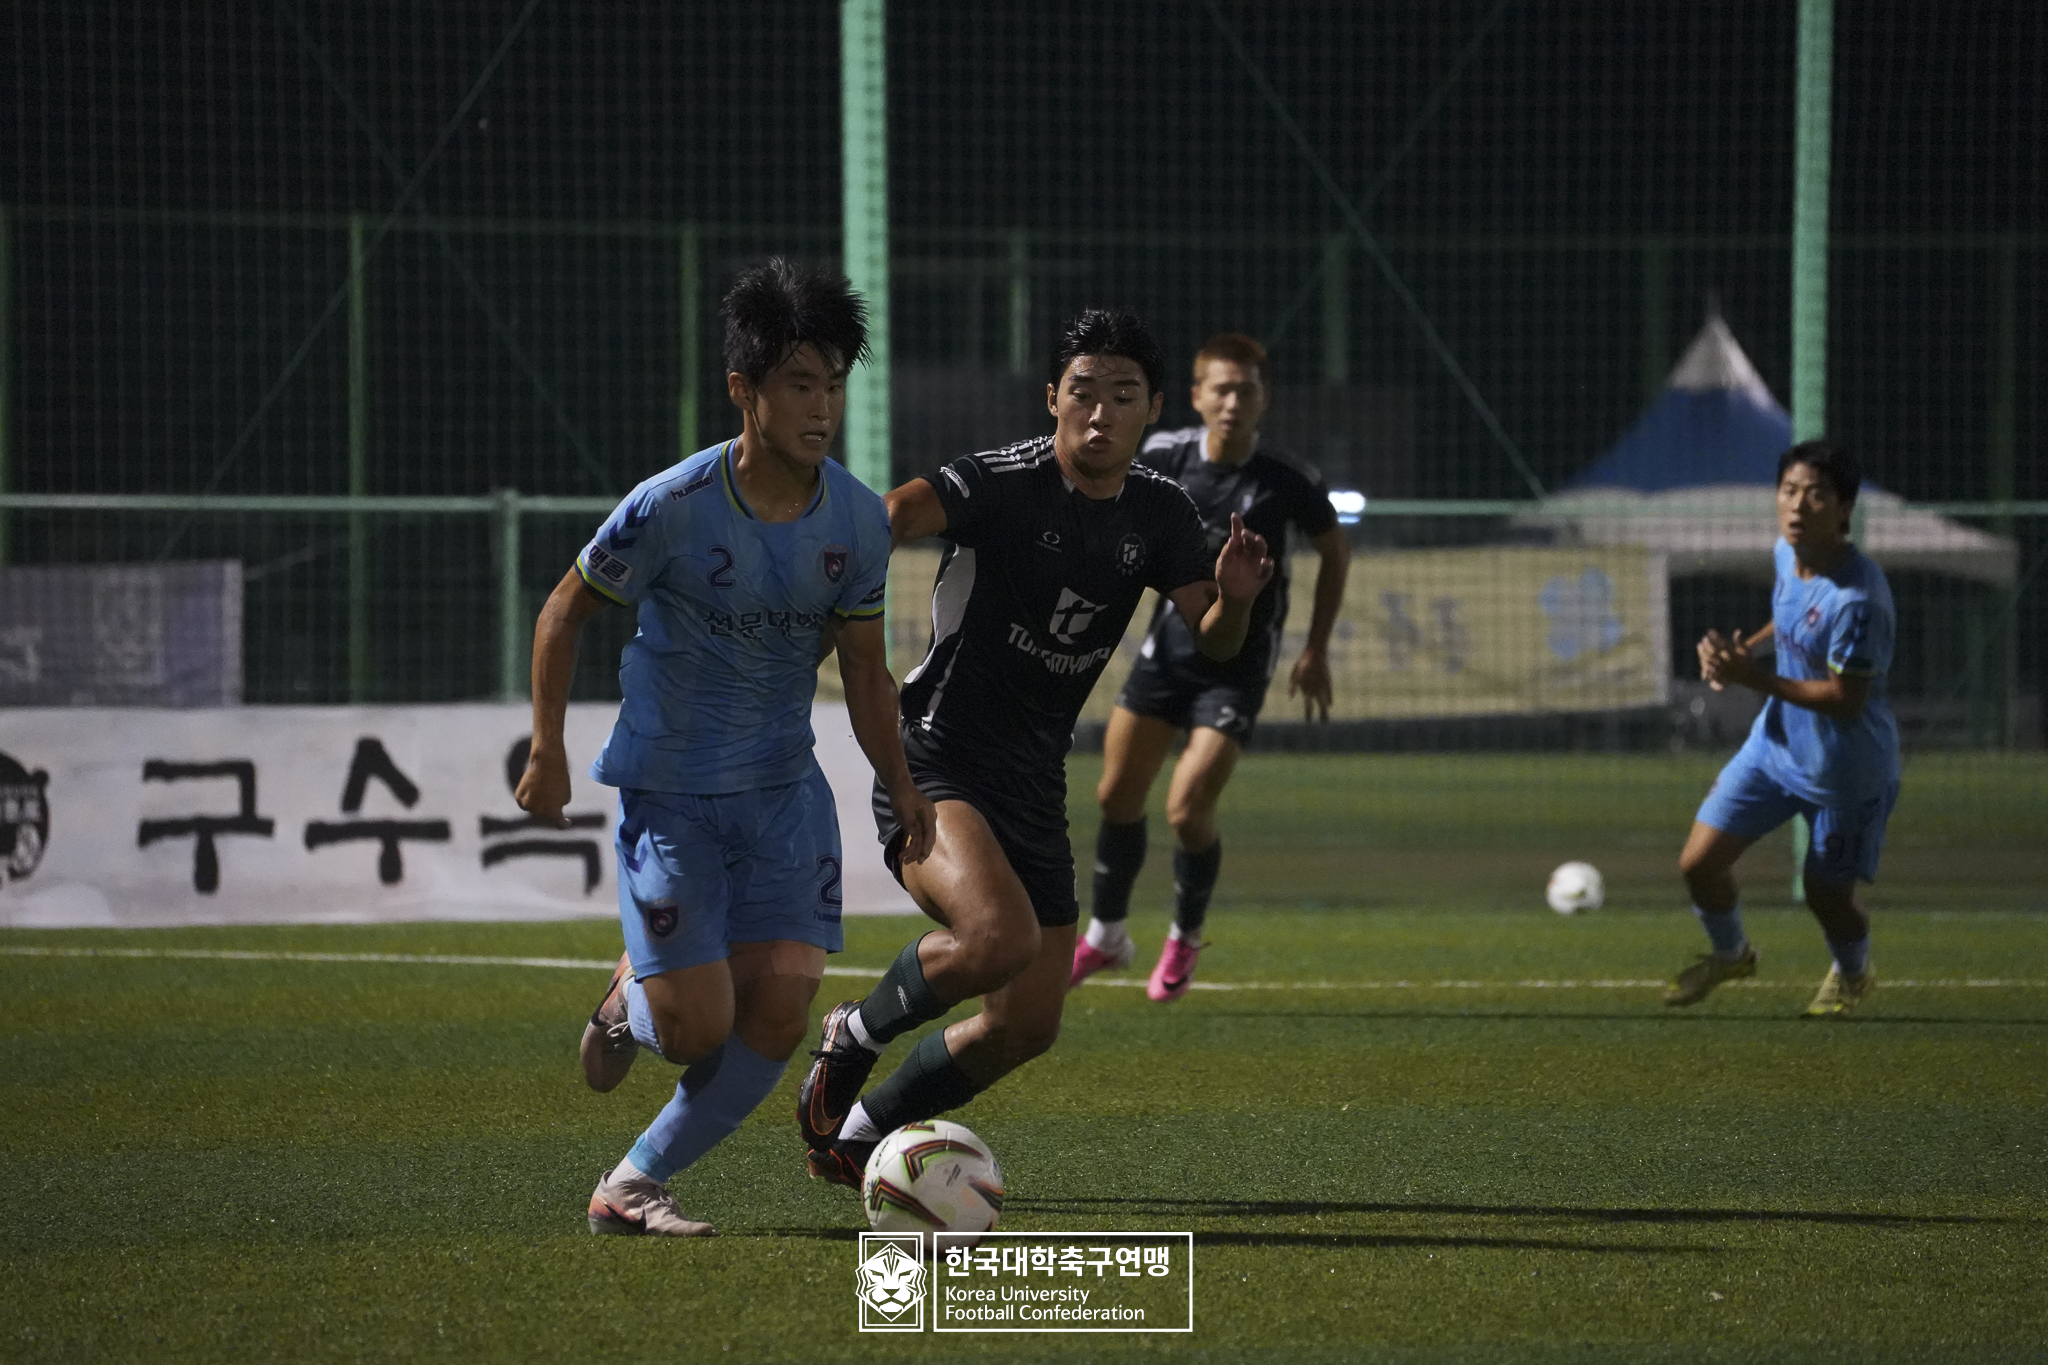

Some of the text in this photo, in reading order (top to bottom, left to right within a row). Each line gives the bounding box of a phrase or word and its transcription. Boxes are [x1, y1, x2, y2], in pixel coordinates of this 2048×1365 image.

[670, 471, 714, 501] hummel
[589, 545, 629, 582] 맥콜
[708, 545, 735, 589] 2
[816, 855, 842, 908] 2
